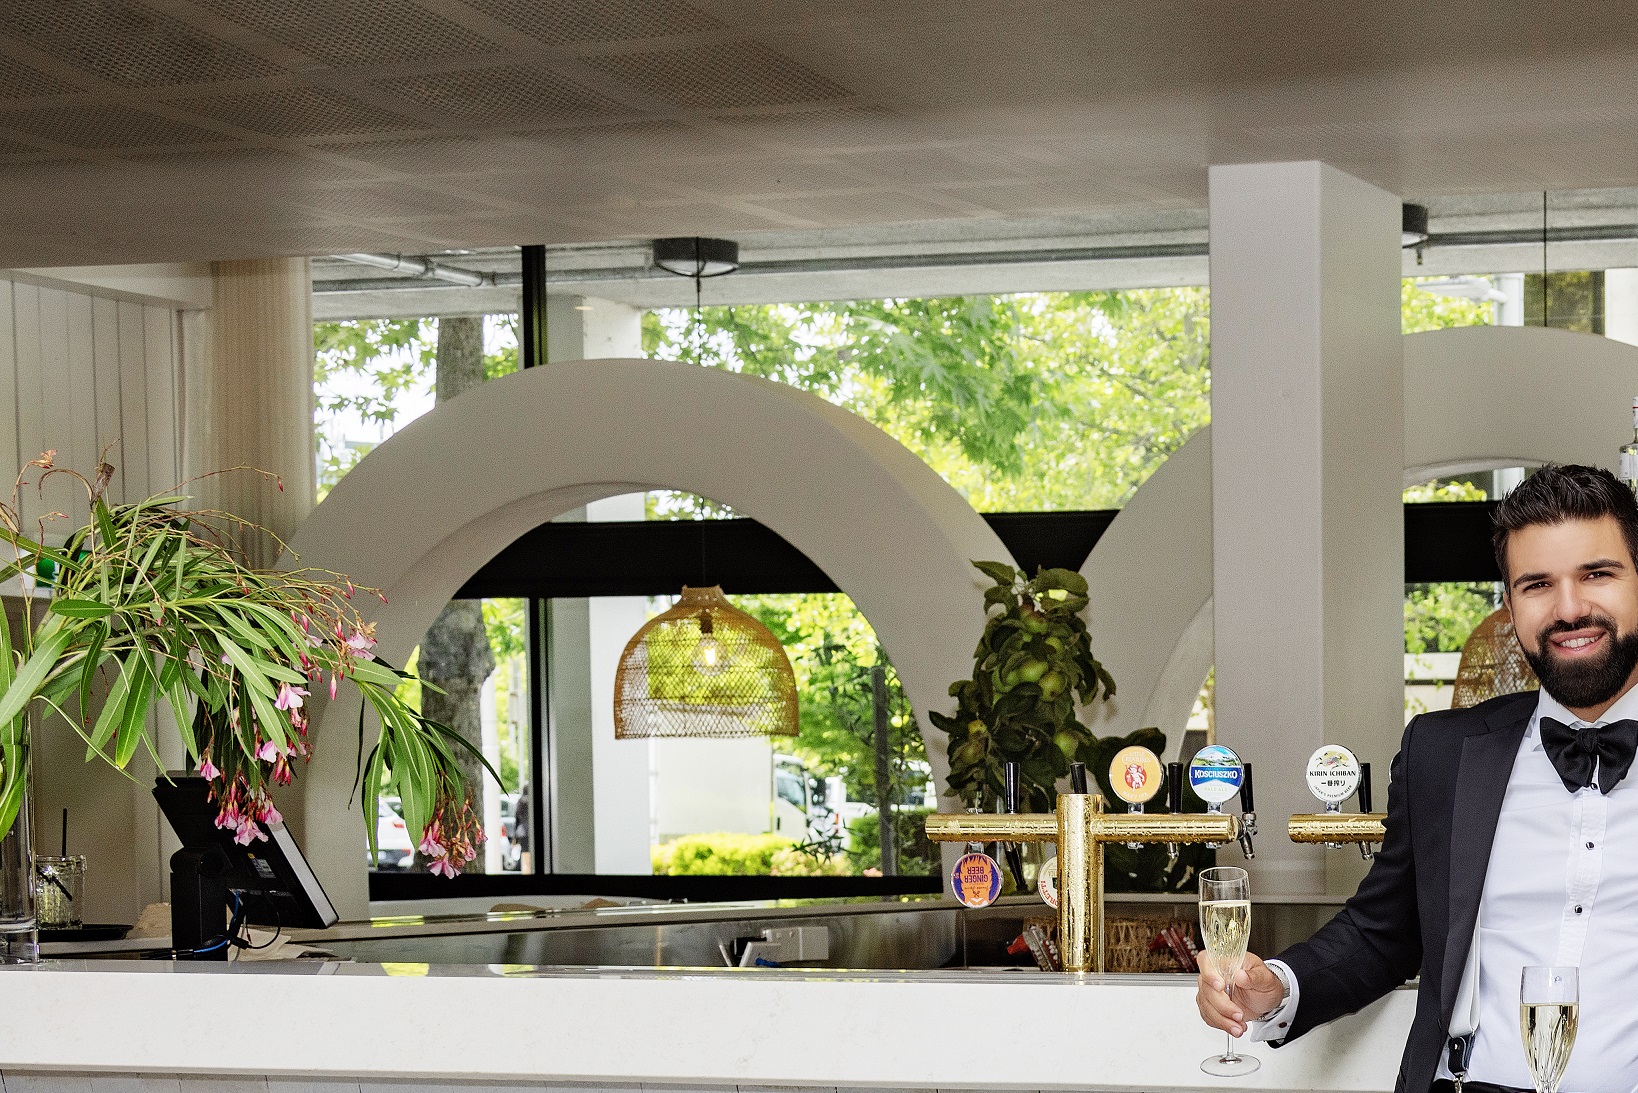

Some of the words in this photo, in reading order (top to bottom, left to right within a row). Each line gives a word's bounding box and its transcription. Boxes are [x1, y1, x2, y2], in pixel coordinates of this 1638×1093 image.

[1194, 769, 1238, 779] KOSCIUSZKO
[967, 866, 984, 874] BEER
[964, 874, 989, 883] GINGER
[1040, 880, 1058, 906] ORETTI
